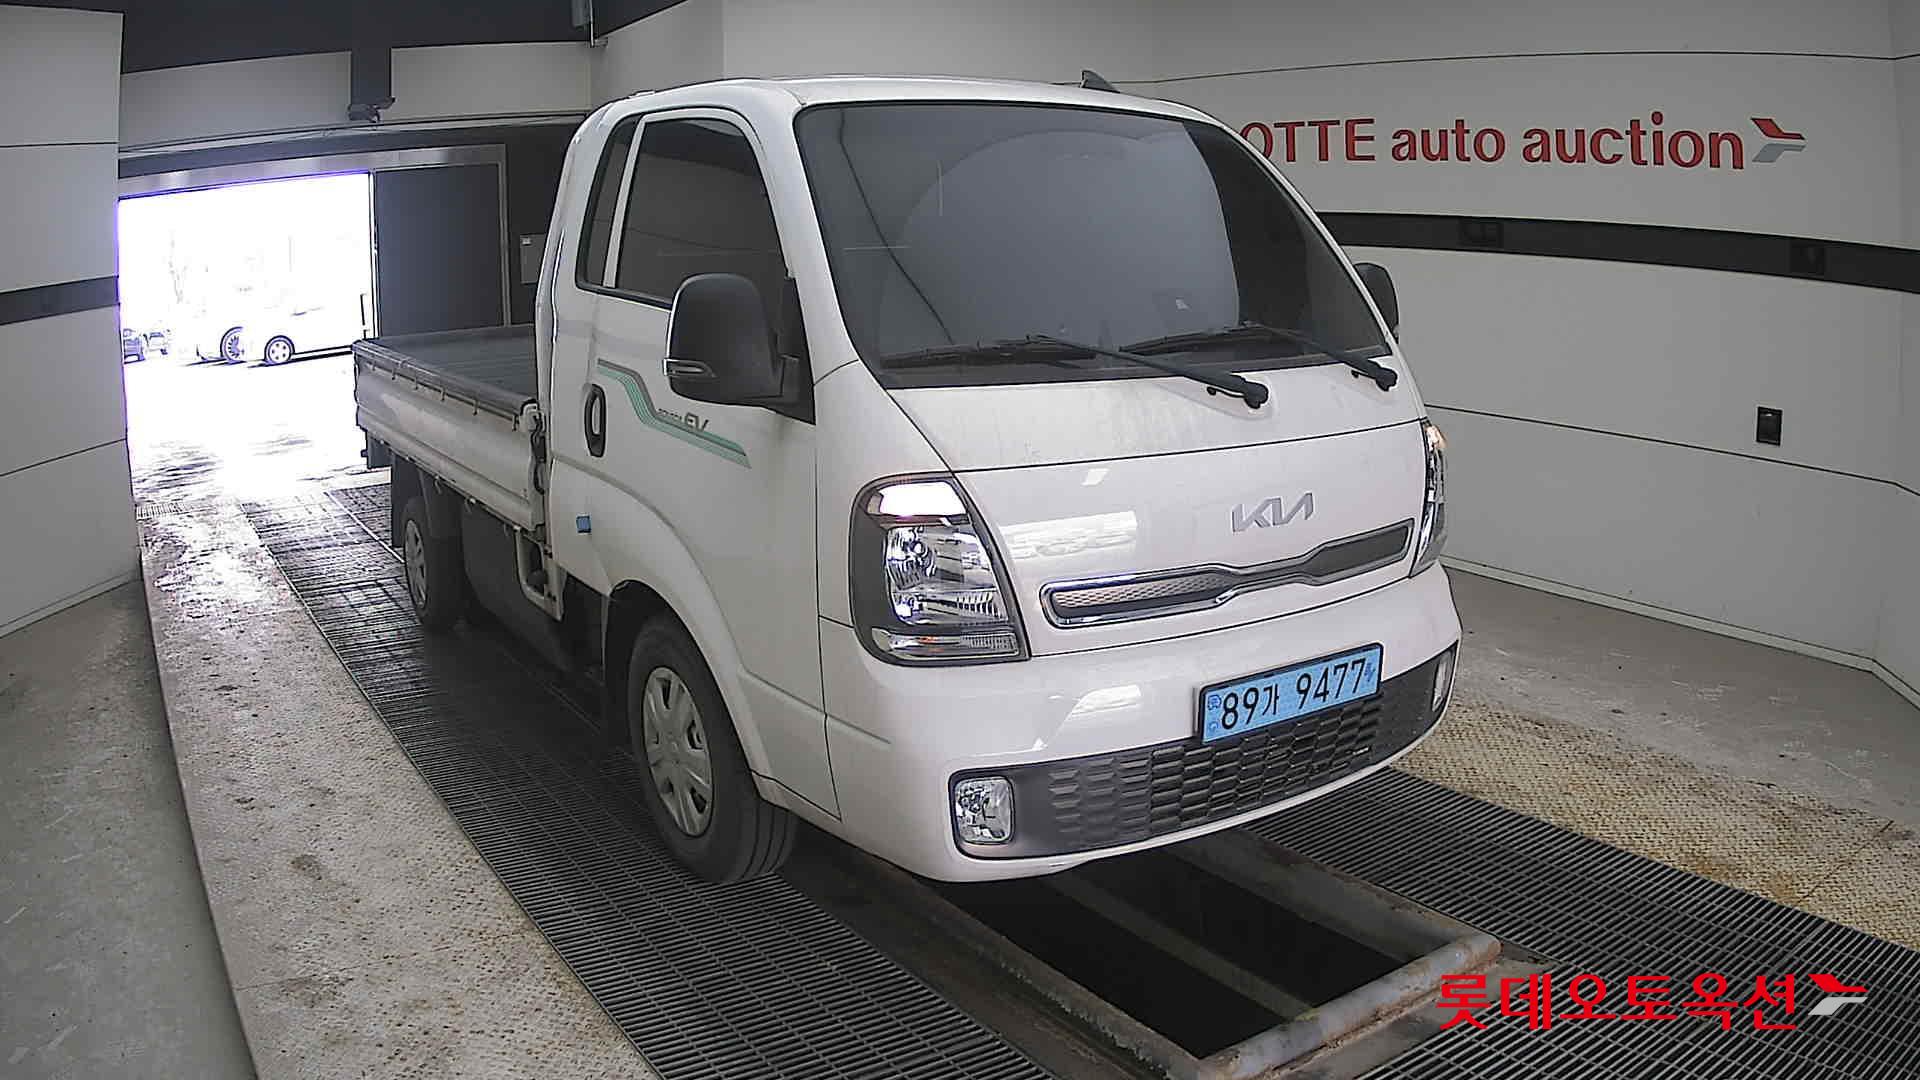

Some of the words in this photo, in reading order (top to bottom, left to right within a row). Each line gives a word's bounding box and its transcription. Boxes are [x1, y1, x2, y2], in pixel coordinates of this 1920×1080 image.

[1240, 117, 1375, 163] OTTE
[1391, 118, 1505, 164] auto
[1522, 111, 1745, 170] auction
[1232, 492, 1313, 532] KIA
[1222, 684, 1279, 730] 89가
[1296, 658, 1366, 709] 9477
